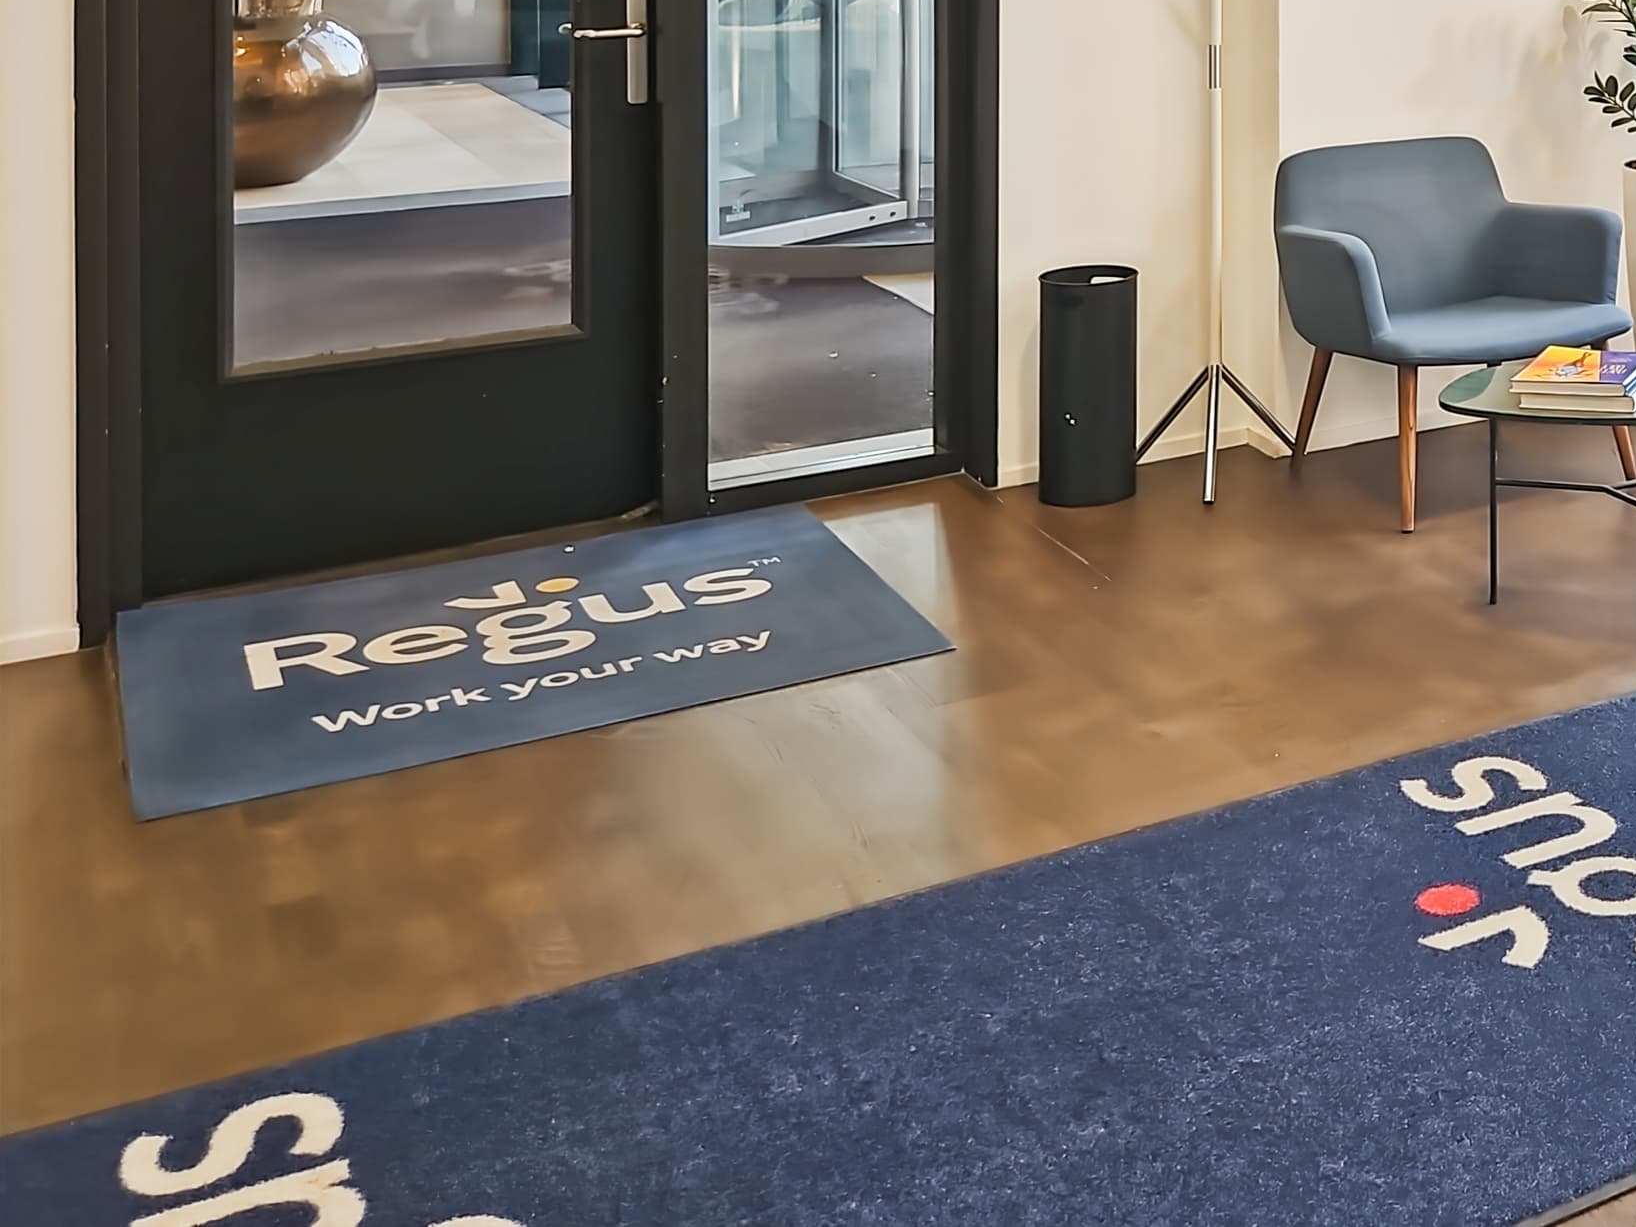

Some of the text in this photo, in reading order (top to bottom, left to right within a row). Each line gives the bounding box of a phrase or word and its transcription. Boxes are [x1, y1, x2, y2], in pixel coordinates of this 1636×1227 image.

[242, 567, 773, 691] Regus
[311, 628, 773, 736] Work your way
